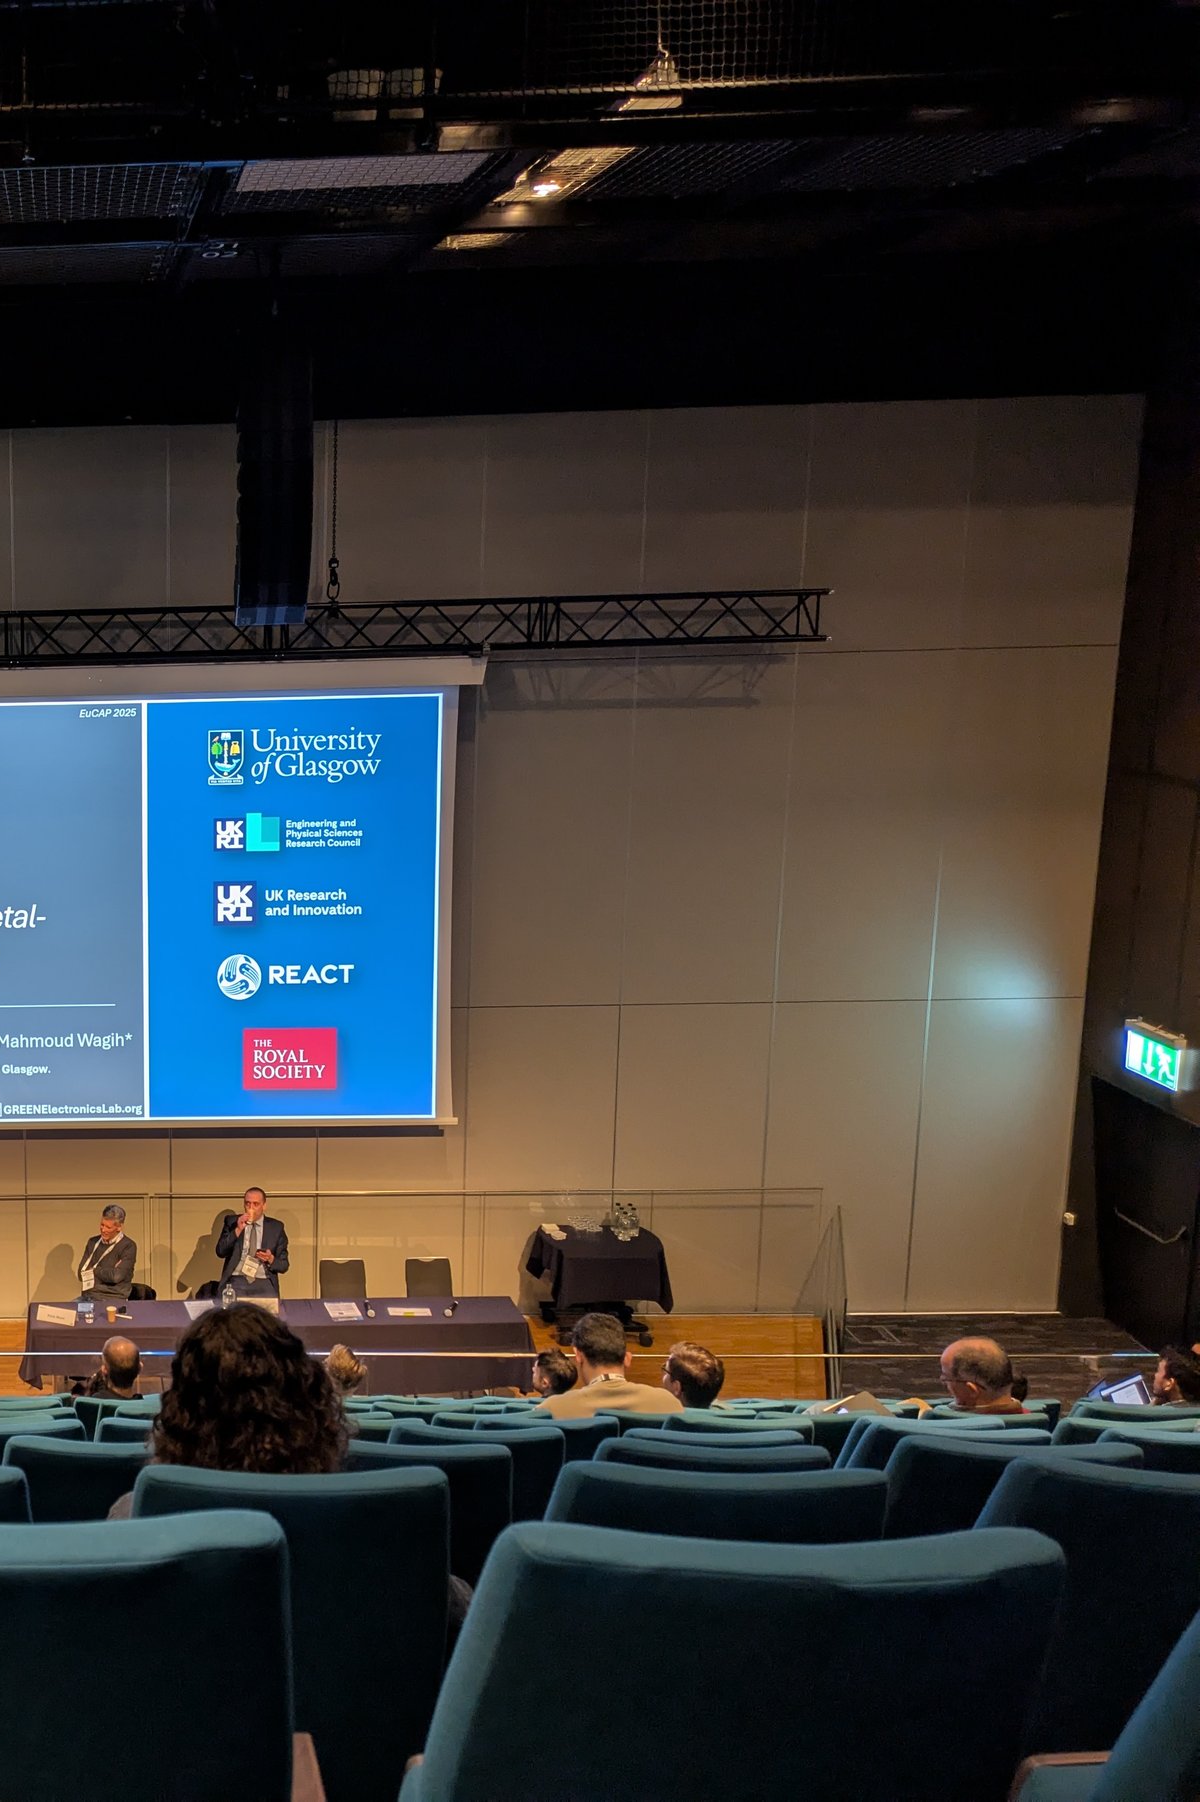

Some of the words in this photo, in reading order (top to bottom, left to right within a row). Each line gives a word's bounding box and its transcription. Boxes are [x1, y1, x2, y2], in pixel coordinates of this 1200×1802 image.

[79, 708, 111, 718] EuCAP
[113, 708, 136, 718] 2025
[250, 726, 382, 757] University
[251, 752, 277, 785] of
[275, 751, 381, 783] Glasgow
[216, 820, 244, 835] UK
[285, 819, 337, 830] Engineering
[339, 818, 357, 828] and
[285, 829, 322, 839] Physical
[323, 828, 363, 838] Sciences
[285, 838, 325, 848] Research
[327, 838, 361, 848] Council
[217, 884, 253, 907] UK
[265, 889, 285, 902] UK
[287, 888, 347, 901] Research
[265, 904, 289, 916] and
[293, 903, 363, 916] Innovation
[268, 964, 355, 985] REACT
[253, 1039, 273, 1048] THE
[253, 1049, 309, 1064] ROYAL
[1, 1064, 51, 1076] Glasgow.
[252, 1065, 326, 1080] SOCIETY
[3, 1103, 143, 1115] GREENElectronicsLab.org
